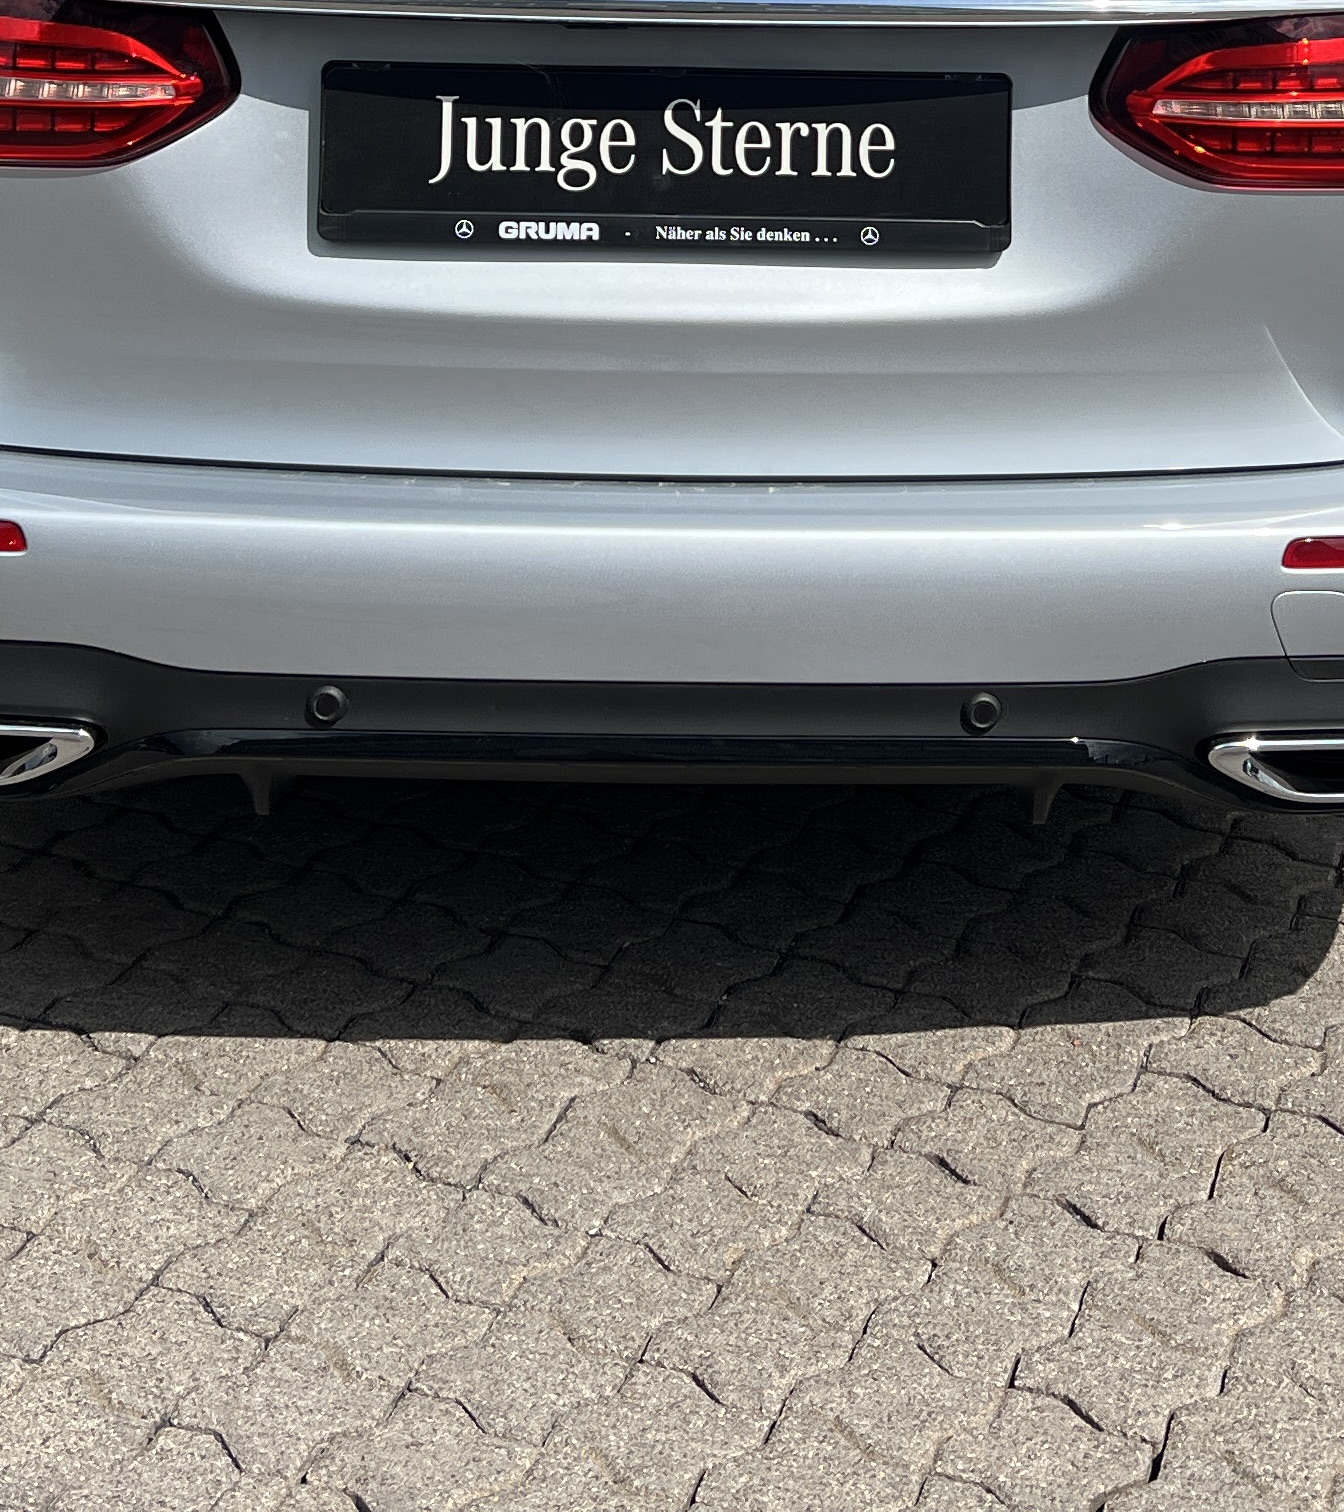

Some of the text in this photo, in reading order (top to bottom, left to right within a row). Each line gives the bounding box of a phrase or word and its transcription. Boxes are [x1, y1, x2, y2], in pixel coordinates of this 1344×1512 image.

[428, 95, 896, 192] Junge Sterne
[498, 221, 600, 241] GRUMA
[655, 224, 703, 242] Näher
[705, 226, 726, 242] als
[730, 227, 753, 242] Sie
